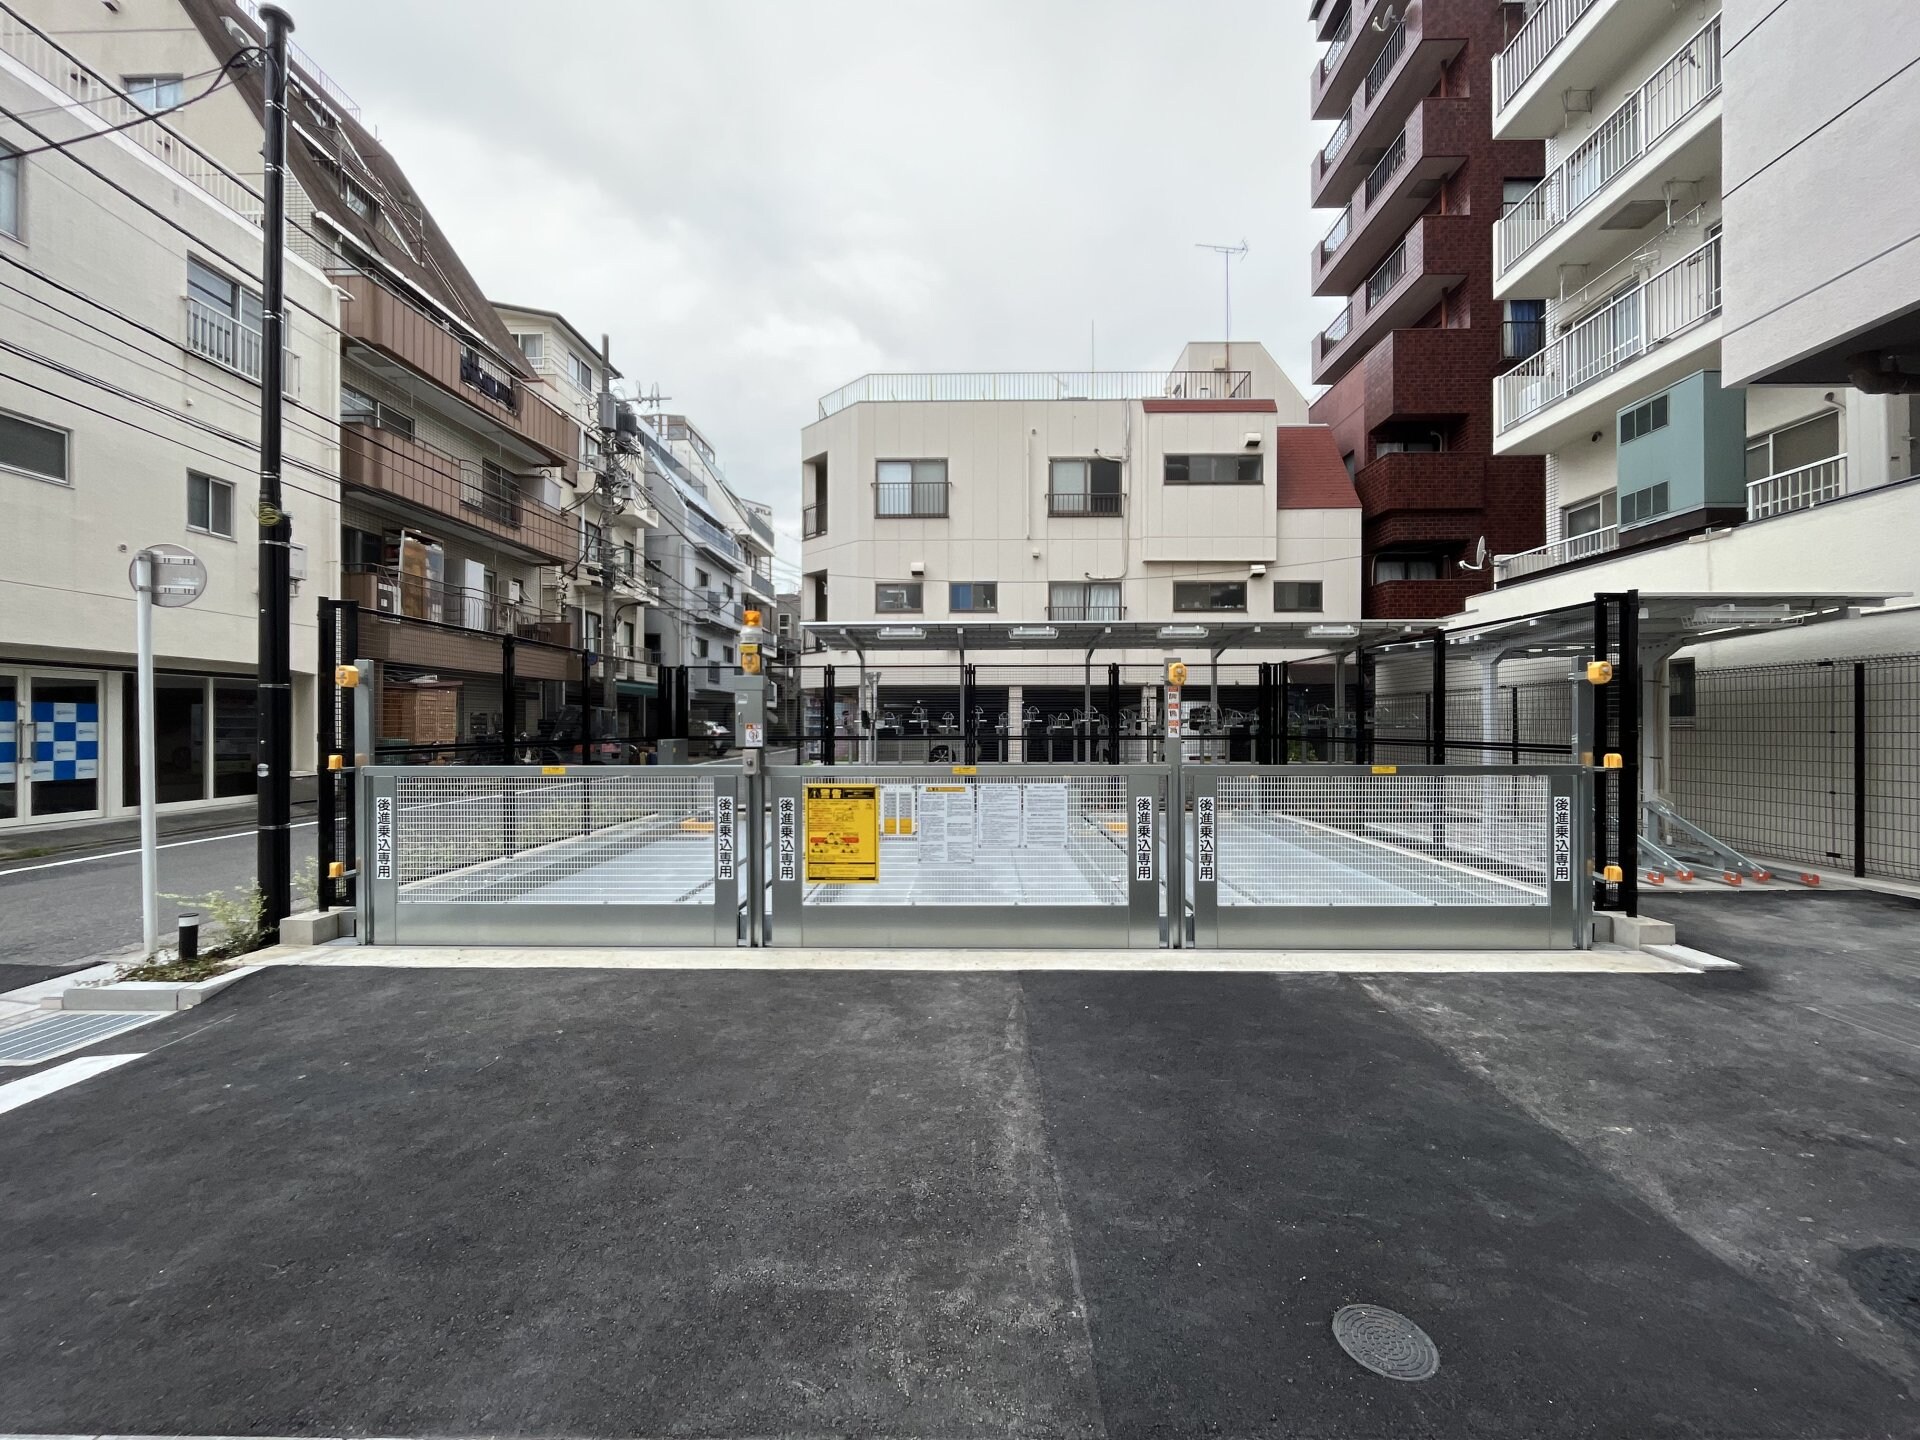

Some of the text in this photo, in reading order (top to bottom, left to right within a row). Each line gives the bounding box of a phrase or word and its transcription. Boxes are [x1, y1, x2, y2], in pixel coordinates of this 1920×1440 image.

[377, 798, 391, 878] 後進乗込専用
[719, 798, 732, 878] 後進乗込専用
[780, 798, 794, 879] 後進乗込専用
[1137, 798, 1151, 879] 後進乗込専用
[1199, 798, 1213, 880] 後進乗込専用
[1555, 798, 1569, 880] 後進乗込専用
